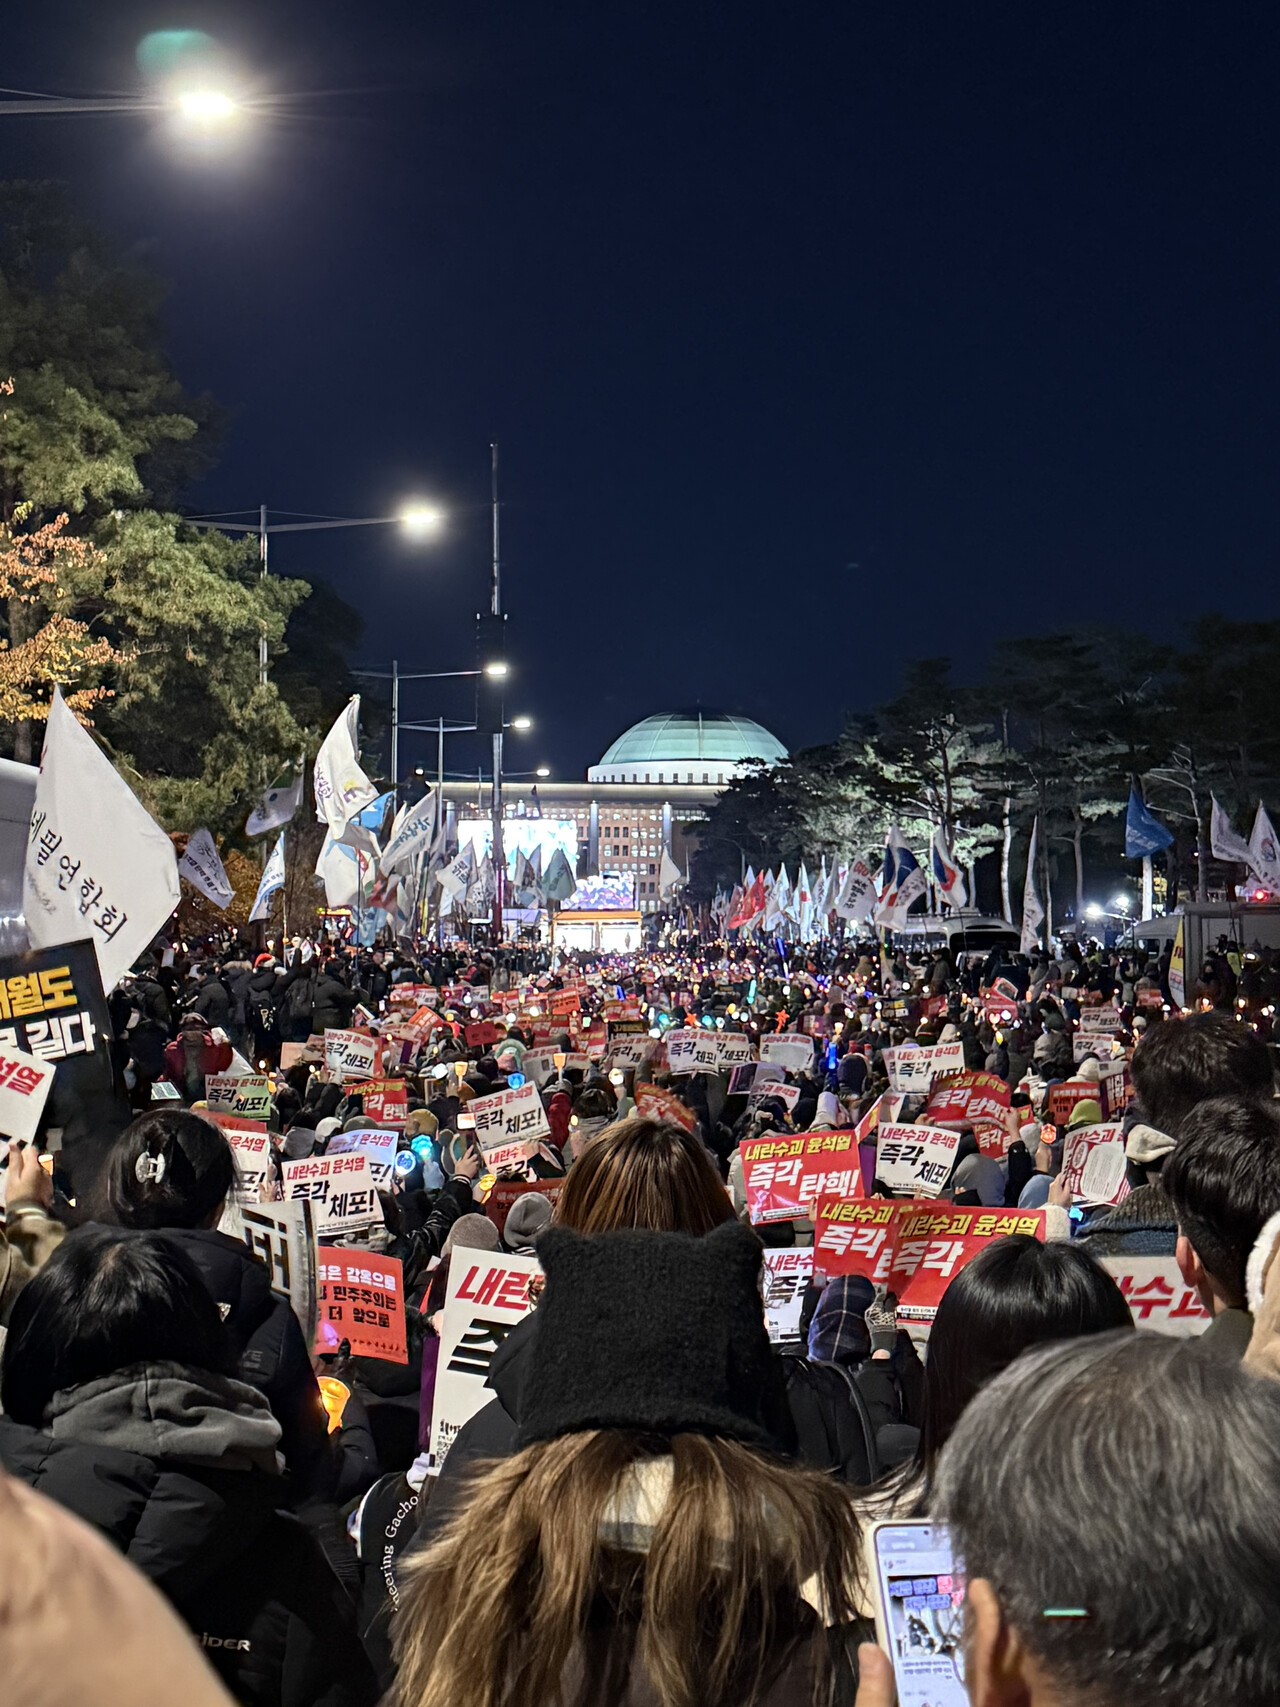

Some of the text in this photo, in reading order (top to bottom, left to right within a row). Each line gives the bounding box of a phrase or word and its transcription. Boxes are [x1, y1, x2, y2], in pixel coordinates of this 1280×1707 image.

[0, 965, 77, 1018] 월도
[26, 1012, 95, 1060] 길다
[341, 1052, 374, 1070] 체포!
[671, 1042, 697, 1057] 즉각
[899, 1061, 932, 1078] 즉각
[208, 1088, 269, 1112] 즉각 체포!
[364, 1093, 385, 1111] 각
[929, 1088, 973, 1108] 즉각
[476, 1107, 542, 1135] 즉각 체포!
[230, 1134, 267, 1153] 윤석열
[359, 1133, 394, 1148] 윤석열
[744, 1134, 852, 1161] 내란수괴 윤석열
[880, 1127, 958, 1150] 내란수괴 윤석열
[489, 1145, 527, 1166] 내란수
[879, 1143, 951, 1186] 즉각 체포!
[286, 1156, 366, 1181] 내란수괴 윤석열
[748, 1158, 860, 1202] 즉각 탄핵!
[291, 1180, 375, 1219] 즉각 체포!
[820, 1201, 893, 1225] 내란수괴
[898, 1213, 973, 1238] 내란수괴
[818, 1224, 887, 1259] 즉각
[768, 1253, 814, 1271] 내란수
[892, 1240, 965, 1278] 즉각
[332, 1285, 397, 1311] 민주주의는
[455, 1265, 546, 1311] 내란
[328, 1305, 342, 1321] 더
[446, 1318, 518, 1388] 즉
[384, 1494, 420, 1538] Gacho
